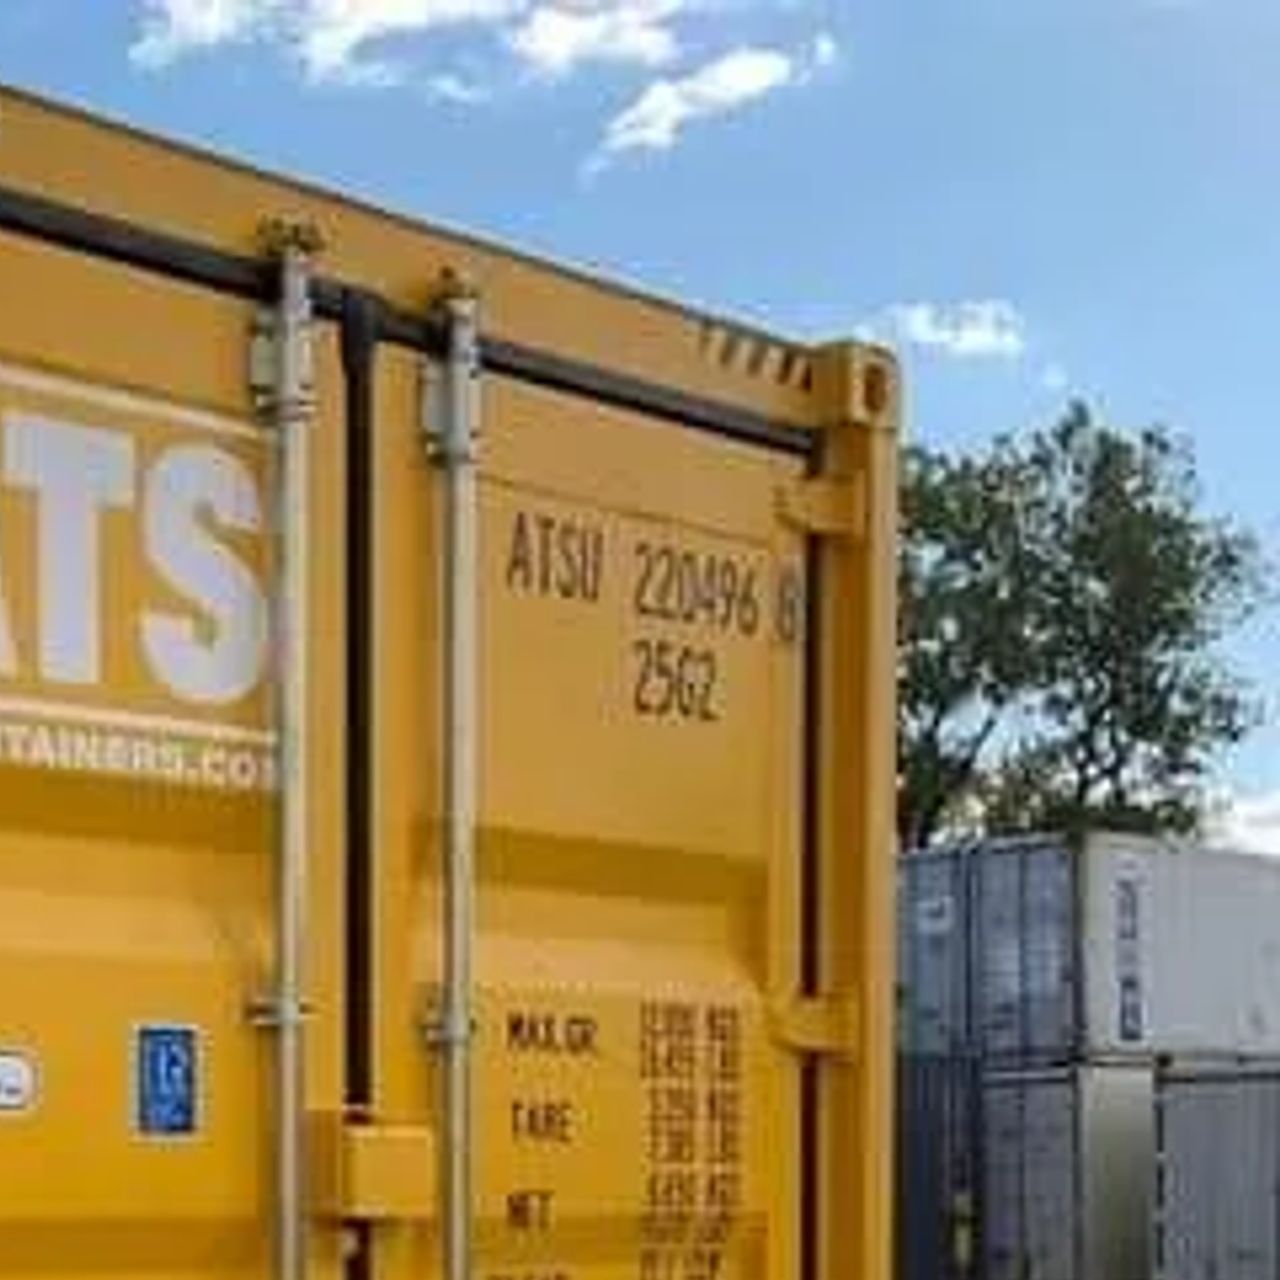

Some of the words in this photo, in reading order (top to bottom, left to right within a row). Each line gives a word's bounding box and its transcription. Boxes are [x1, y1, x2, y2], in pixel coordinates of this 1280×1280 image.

[506, 510, 604, 602] ATSU
[633, 543, 760, 637] 220496
[632, 640, 722, 723] 25G2
